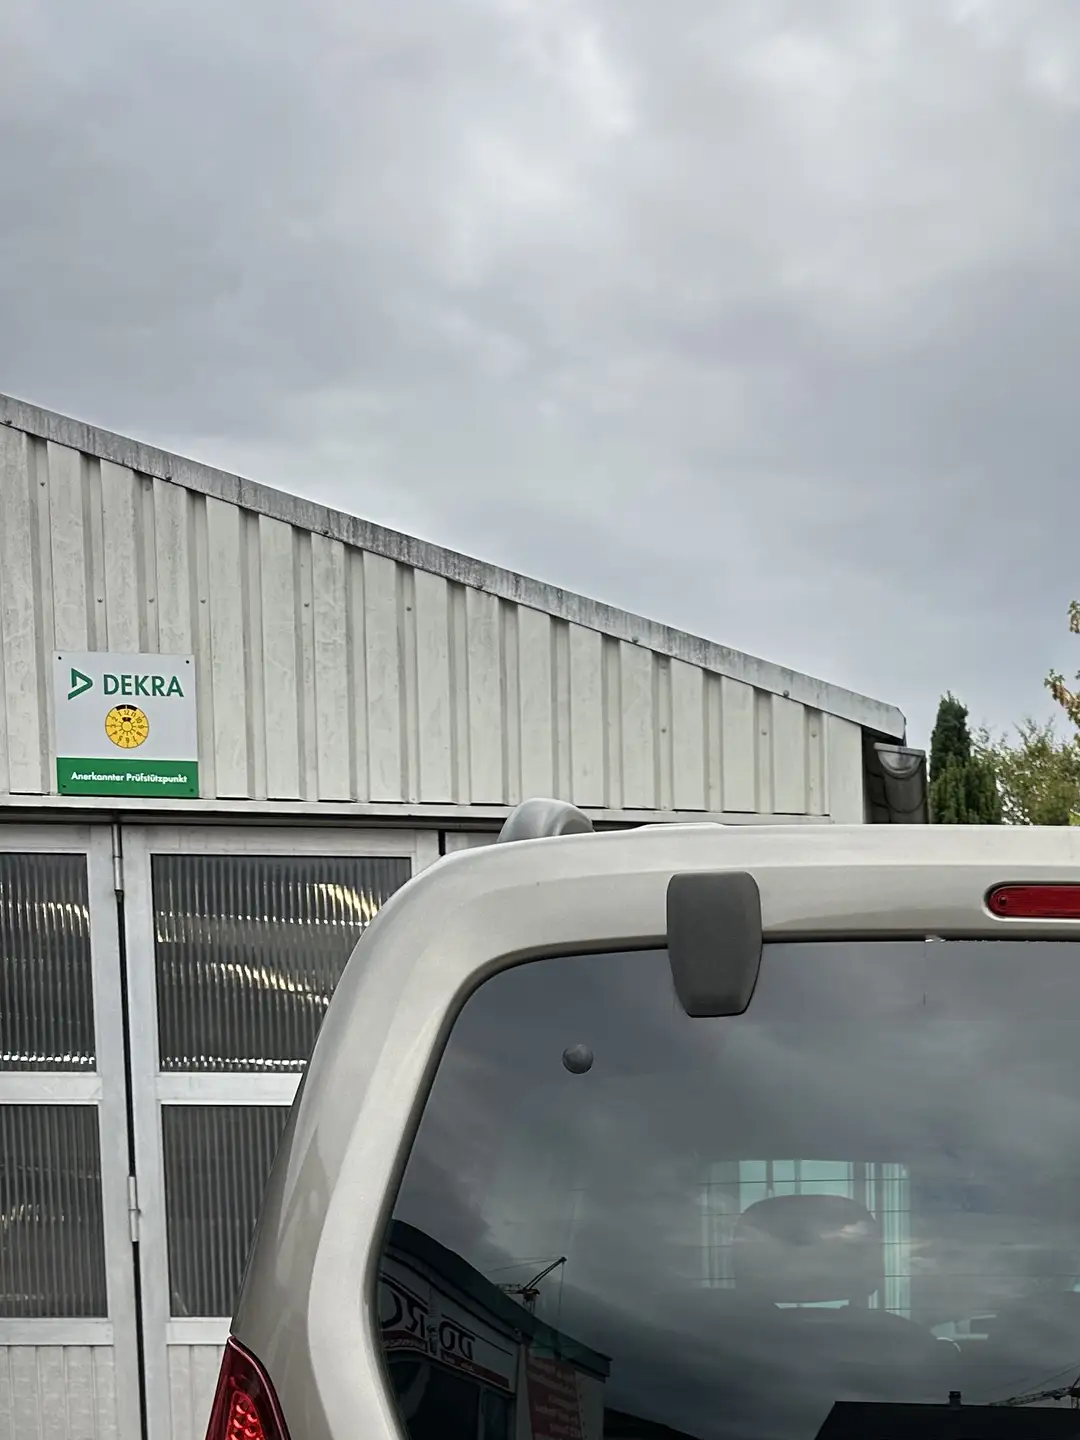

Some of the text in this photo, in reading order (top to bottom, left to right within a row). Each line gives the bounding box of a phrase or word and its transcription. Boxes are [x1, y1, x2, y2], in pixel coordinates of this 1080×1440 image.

[103, 674, 184, 698] DEKRA
[71, 771, 187, 784] Anerkannter Prüfstützpunkt
